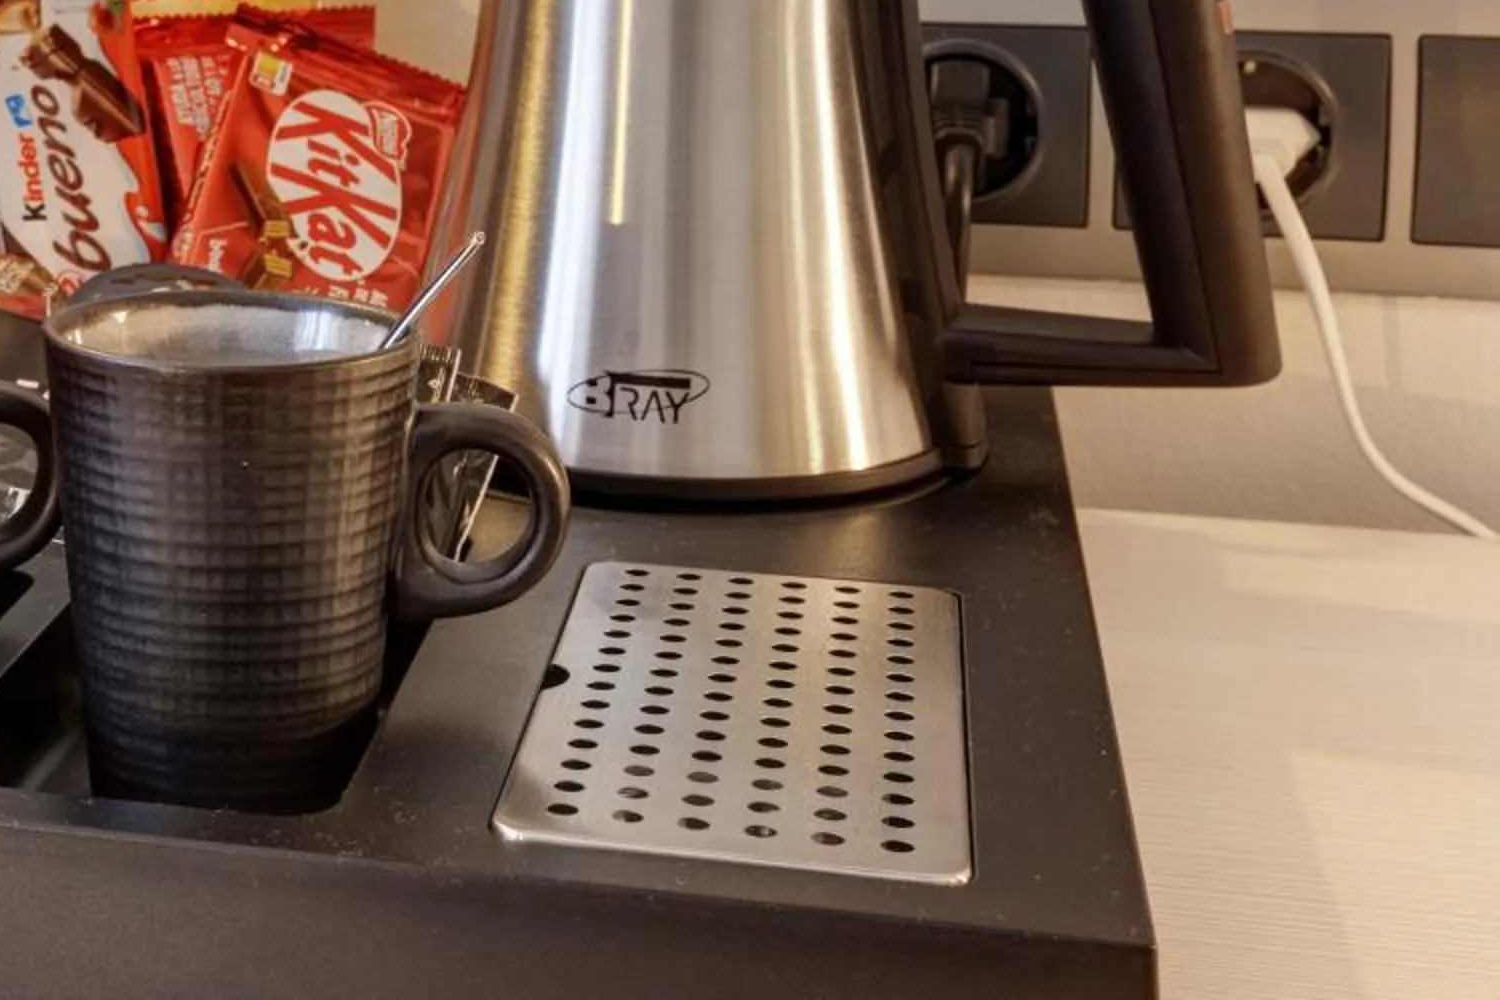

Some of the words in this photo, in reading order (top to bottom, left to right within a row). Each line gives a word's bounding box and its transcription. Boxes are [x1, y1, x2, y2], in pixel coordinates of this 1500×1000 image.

[18, 131, 48, 222] Kinder
[31, 84, 113, 272] bueno
[268, 100, 399, 277] KitKat
